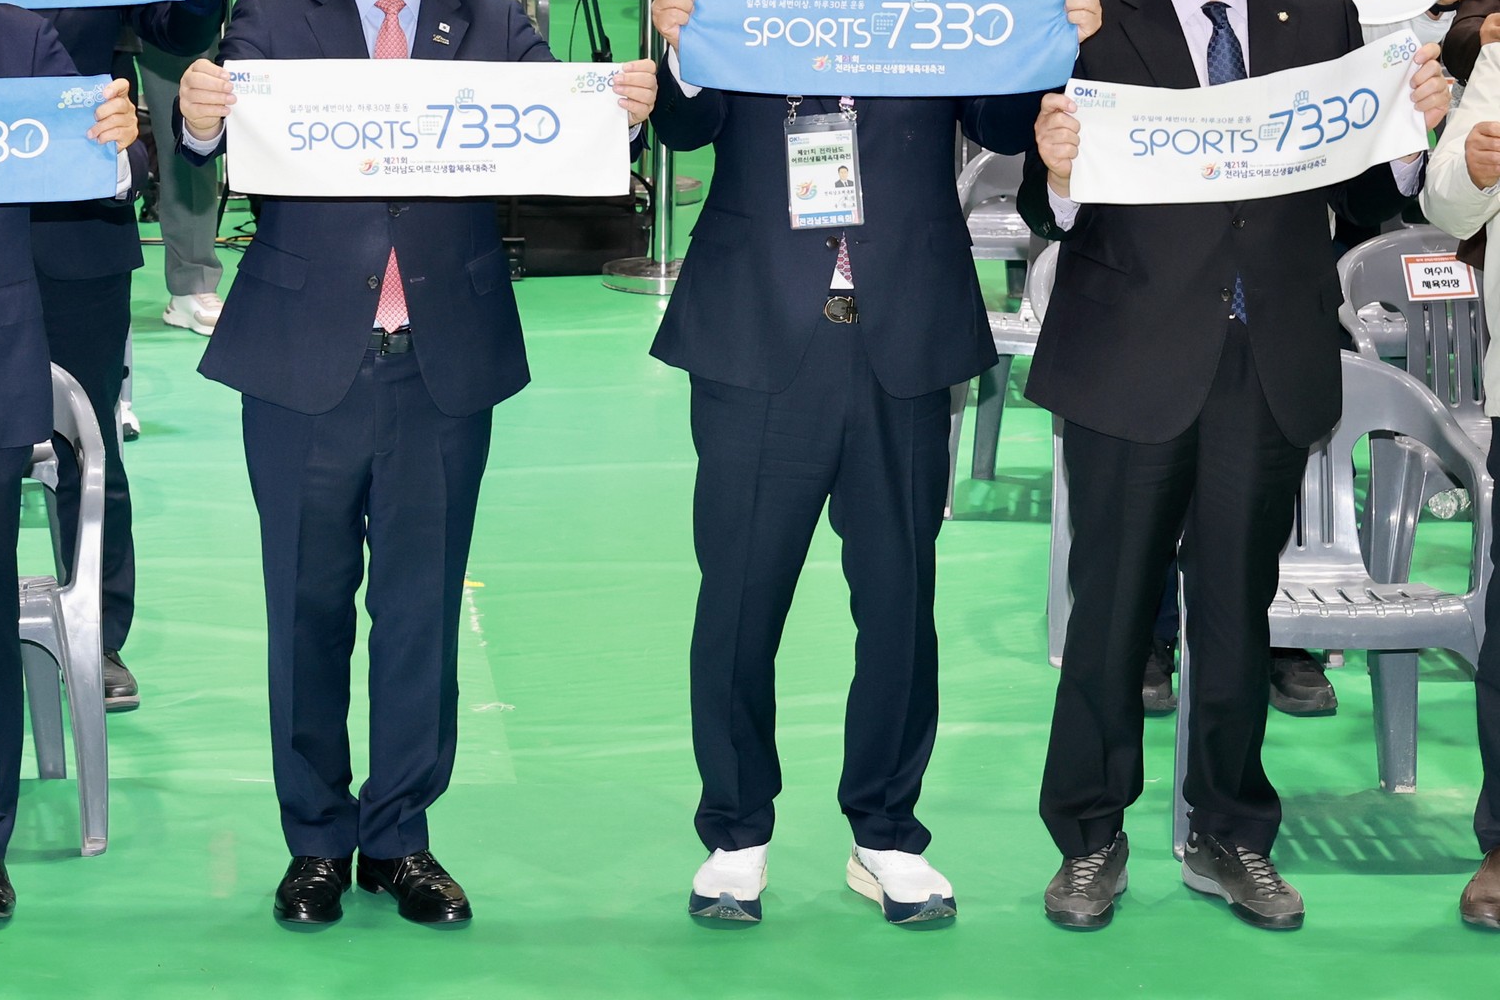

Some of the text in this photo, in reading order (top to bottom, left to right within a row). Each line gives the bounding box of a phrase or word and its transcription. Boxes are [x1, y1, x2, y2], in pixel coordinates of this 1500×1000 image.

[746, 0, 776, 9] 일주일에
[814, 0, 847, 10] 하루30분
[850, 0, 865, 10] 운동
[743, 2, 1014, 50] SPORTS 7330
[1383, 36, 1417, 62] 성장장성
[835, 55, 860, 63] 제21회
[834, 63, 946, 74] 전라남도어르신생활체육대축전
[229, 72, 251, 82] OK!
[1073, 86, 1098, 98] OK!
[289, 103, 320, 113] 일주일에
[357, 103, 391, 113] 하루30분
[394, 103, 409, 112] 운동
[1129, 88, 1380, 157] SPORTS 7330
[1131, 114, 1163, 123] 일주일에
[1200, 116, 1235, 124] 하루30분
[1237, 115, 1252, 124] 운동
[288, 104, 561, 151] SPORTS 7330
[383, 156, 408, 165] 제21회
[1224, 160, 1248, 169] 제21회
[384, 165, 497, 175] 전라남도어르신생활체육대축전
[1224, 158, 1327, 178] 전라남도어르신생활체육대축전
[1424, 266, 1453, 276] 여수시
[1422, 279, 1460, 289] 체육회장
